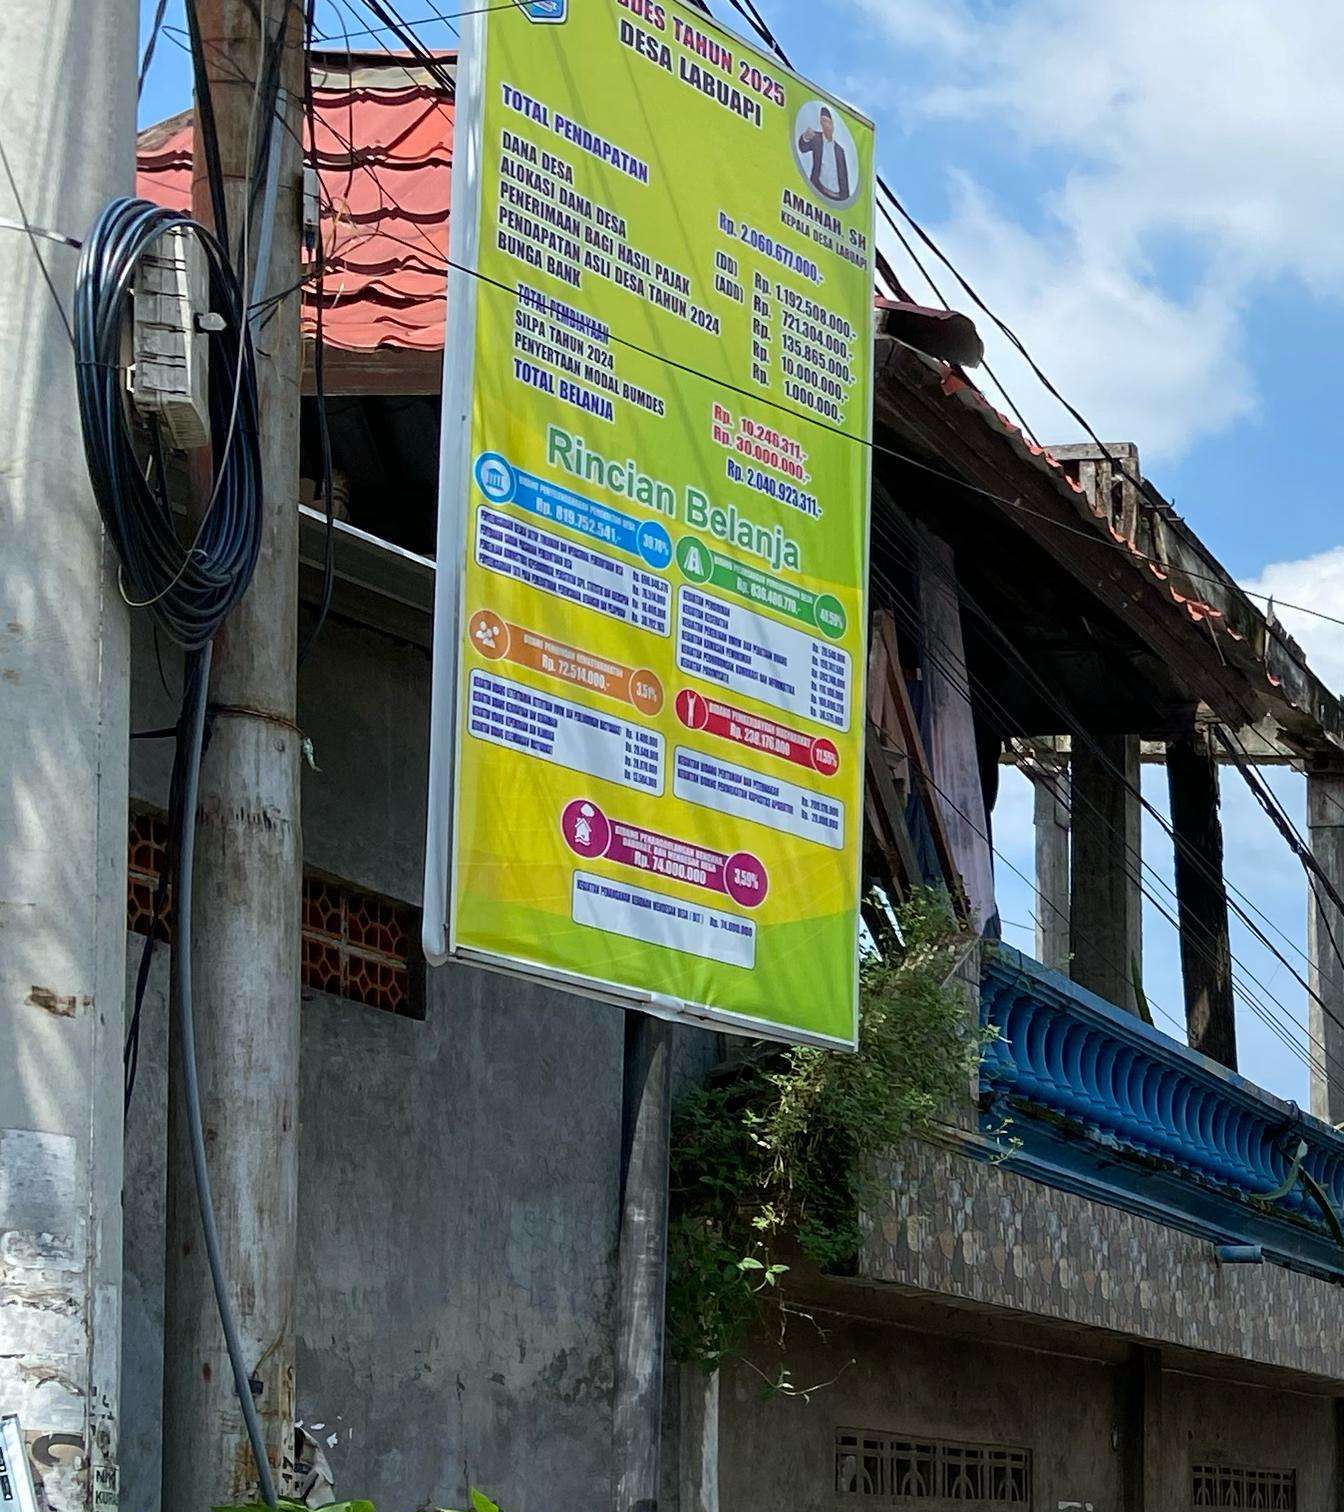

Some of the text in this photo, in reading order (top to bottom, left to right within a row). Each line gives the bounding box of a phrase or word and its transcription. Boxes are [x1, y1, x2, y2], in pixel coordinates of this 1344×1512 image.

[619, 0, 785, 110] DES TAHUN 2025
[620, 16, 760, 128] DESA LABUAPI
[502, 83, 648, 185] TOTAL PENDAPATAN
[502, 128, 572, 185] DANA DESA
[501, 153, 626, 239] ALOKASI DANA DESA
[718, 210, 737, 238] Rp.
[498, 229, 580, 288] BUNGA BANK
[500, 178, 689, 296] PENERIMAAN BAGI HASIL PAJAK
[781, 209, 866, 271] KEPALA DESA LABUAPI
[850, 227, 866, 252] SH
[498, 204, 718, 335] PENDAPATAN ASLI DESA TAHUN 2024
[517, 281, 546, 314] TOTAL
[754, 271, 771, 297] Rp.
[753, 294, 771, 320] Rp.
[753, 317, 770, 343] Rp.
[515, 307, 613, 371] SILPA TAHUN 2024
[752, 340, 769, 365] Rp.
[513, 356, 612, 422] TOTAL BELANJA
[514, 329, 664, 417] PENYERTAAN MODAL BUMDES
[752, 362, 768, 387] Rp.
[713, 403, 732, 428] Rp.
[713, 423, 732, 448] Rp.
[727, 459, 744, 484] Rp.
[548, 424, 674, 517] Rincian
[686, 486, 799, 578] Belanja
